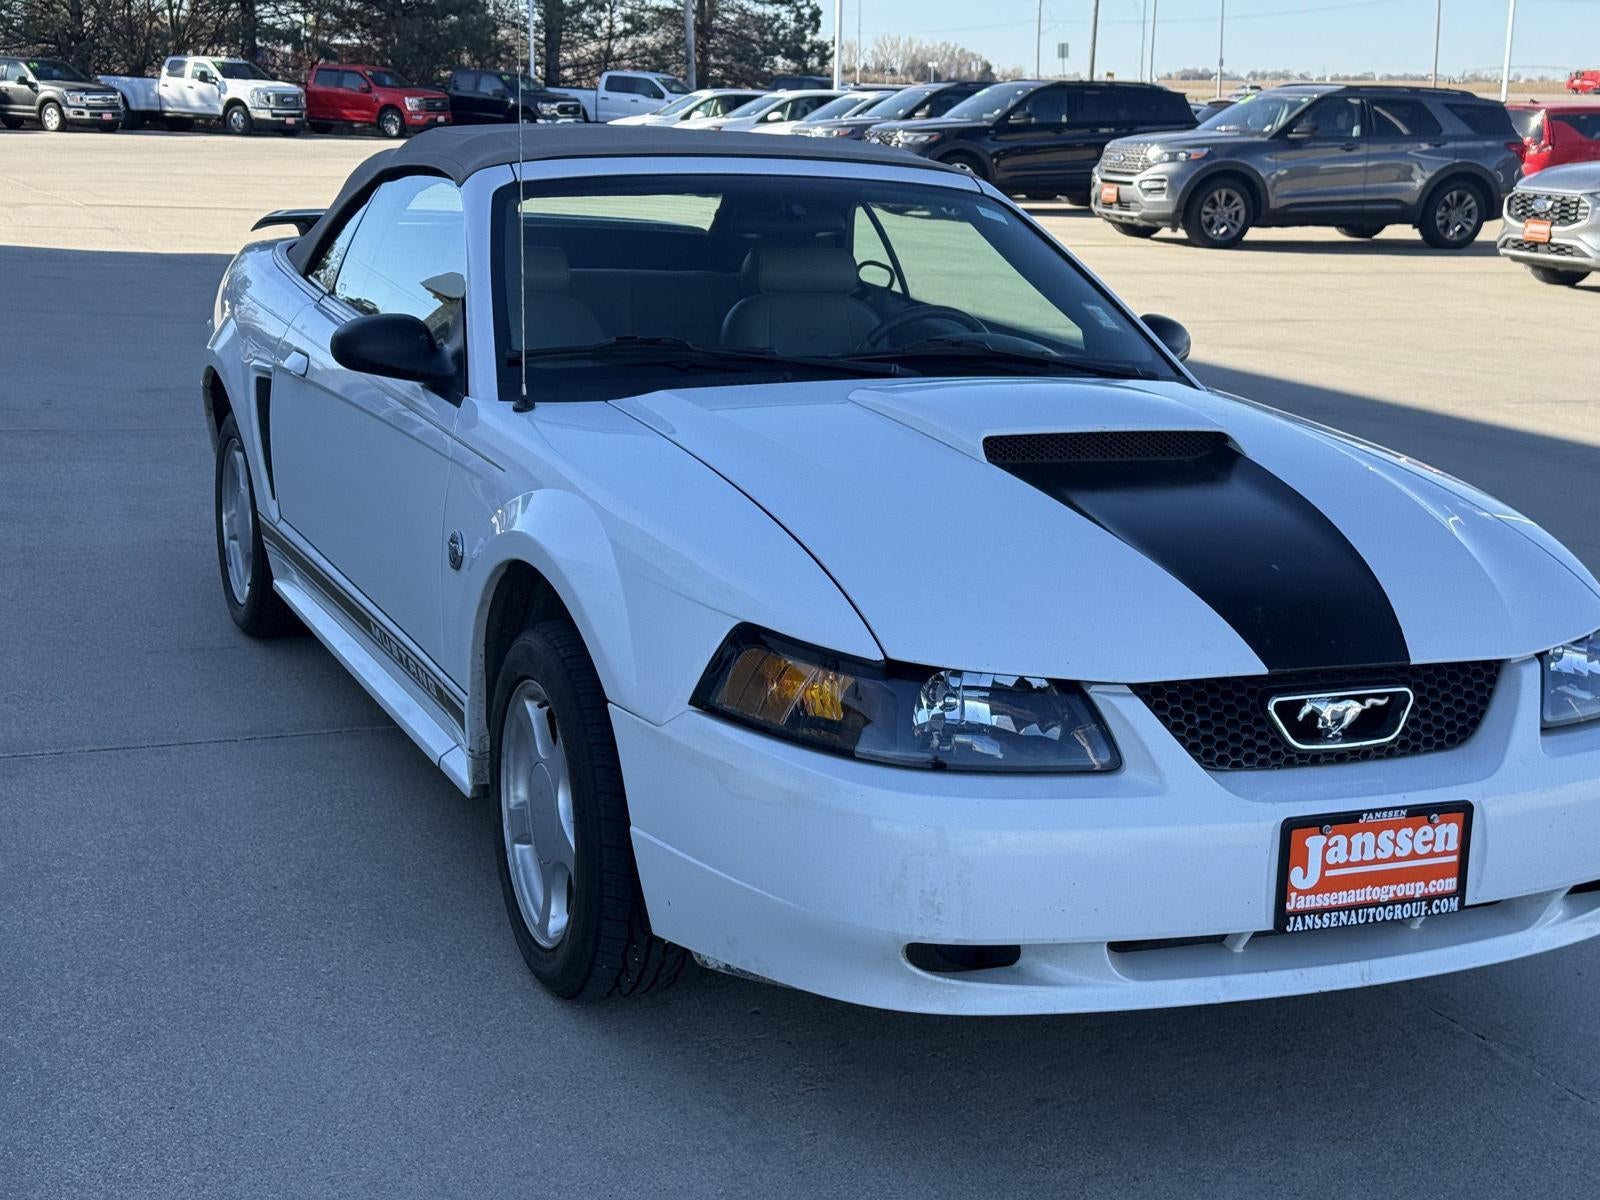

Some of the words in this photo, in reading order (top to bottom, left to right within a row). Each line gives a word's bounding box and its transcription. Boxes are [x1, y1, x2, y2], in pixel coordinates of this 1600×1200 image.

[1358, 809, 1408, 824] JANSSEN
[1289, 822, 1459, 890] Janssen
[1286, 876, 1457, 911] Janssenautogroup.com
